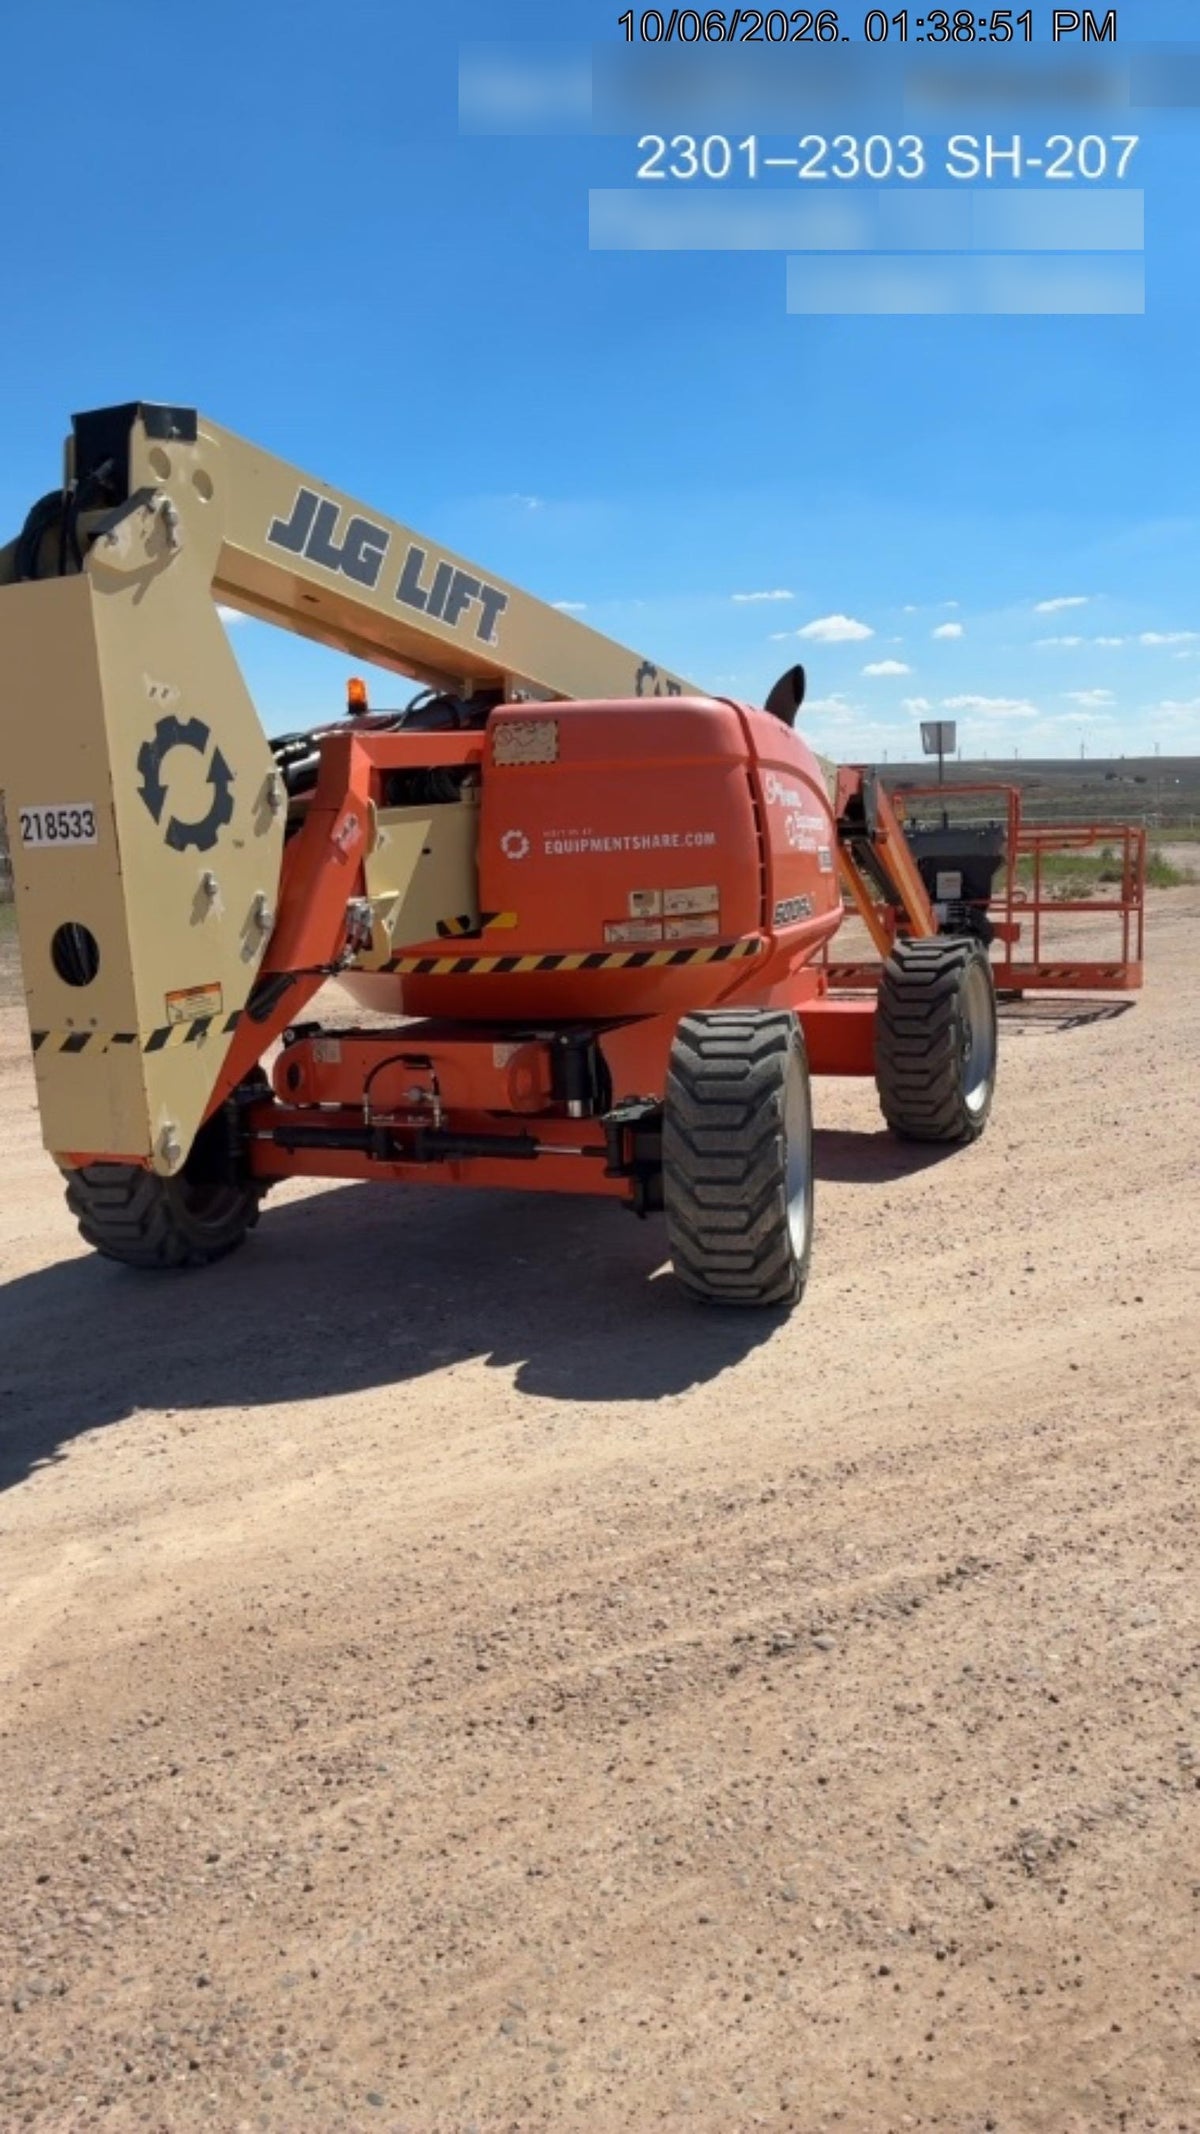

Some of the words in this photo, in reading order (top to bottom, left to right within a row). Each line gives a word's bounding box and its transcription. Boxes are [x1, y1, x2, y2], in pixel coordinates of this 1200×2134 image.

[266, 486, 391, 591] JLG
[395, 543, 509, 647] LIFT
[20, 809, 96, 842] 218533
[544, 831, 716, 855] EQUIPMENTSHARE.COM
